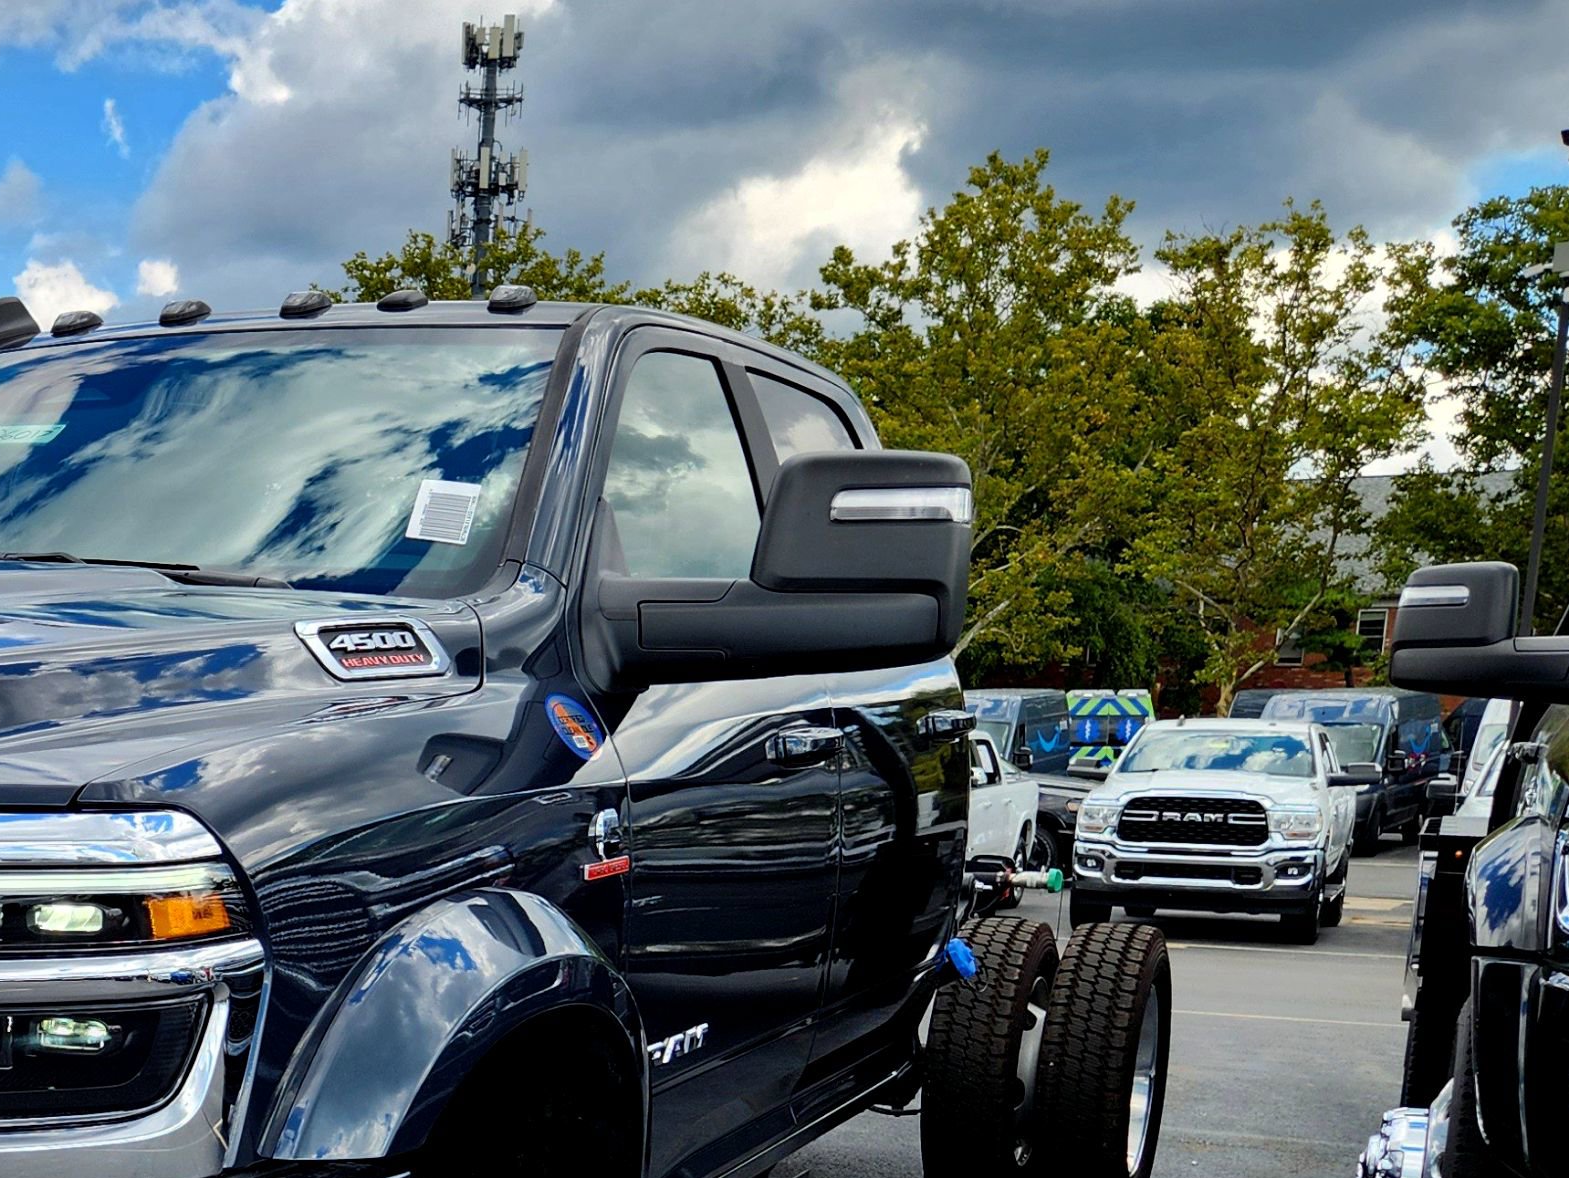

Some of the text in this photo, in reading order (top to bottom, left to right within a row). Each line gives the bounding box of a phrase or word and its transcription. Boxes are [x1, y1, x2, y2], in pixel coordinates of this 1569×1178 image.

[329, 631, 416, 651] 4500
[341, 653, 425, 667] HEAVY DUTY
[1161, 811, 1224, 822] RAM
